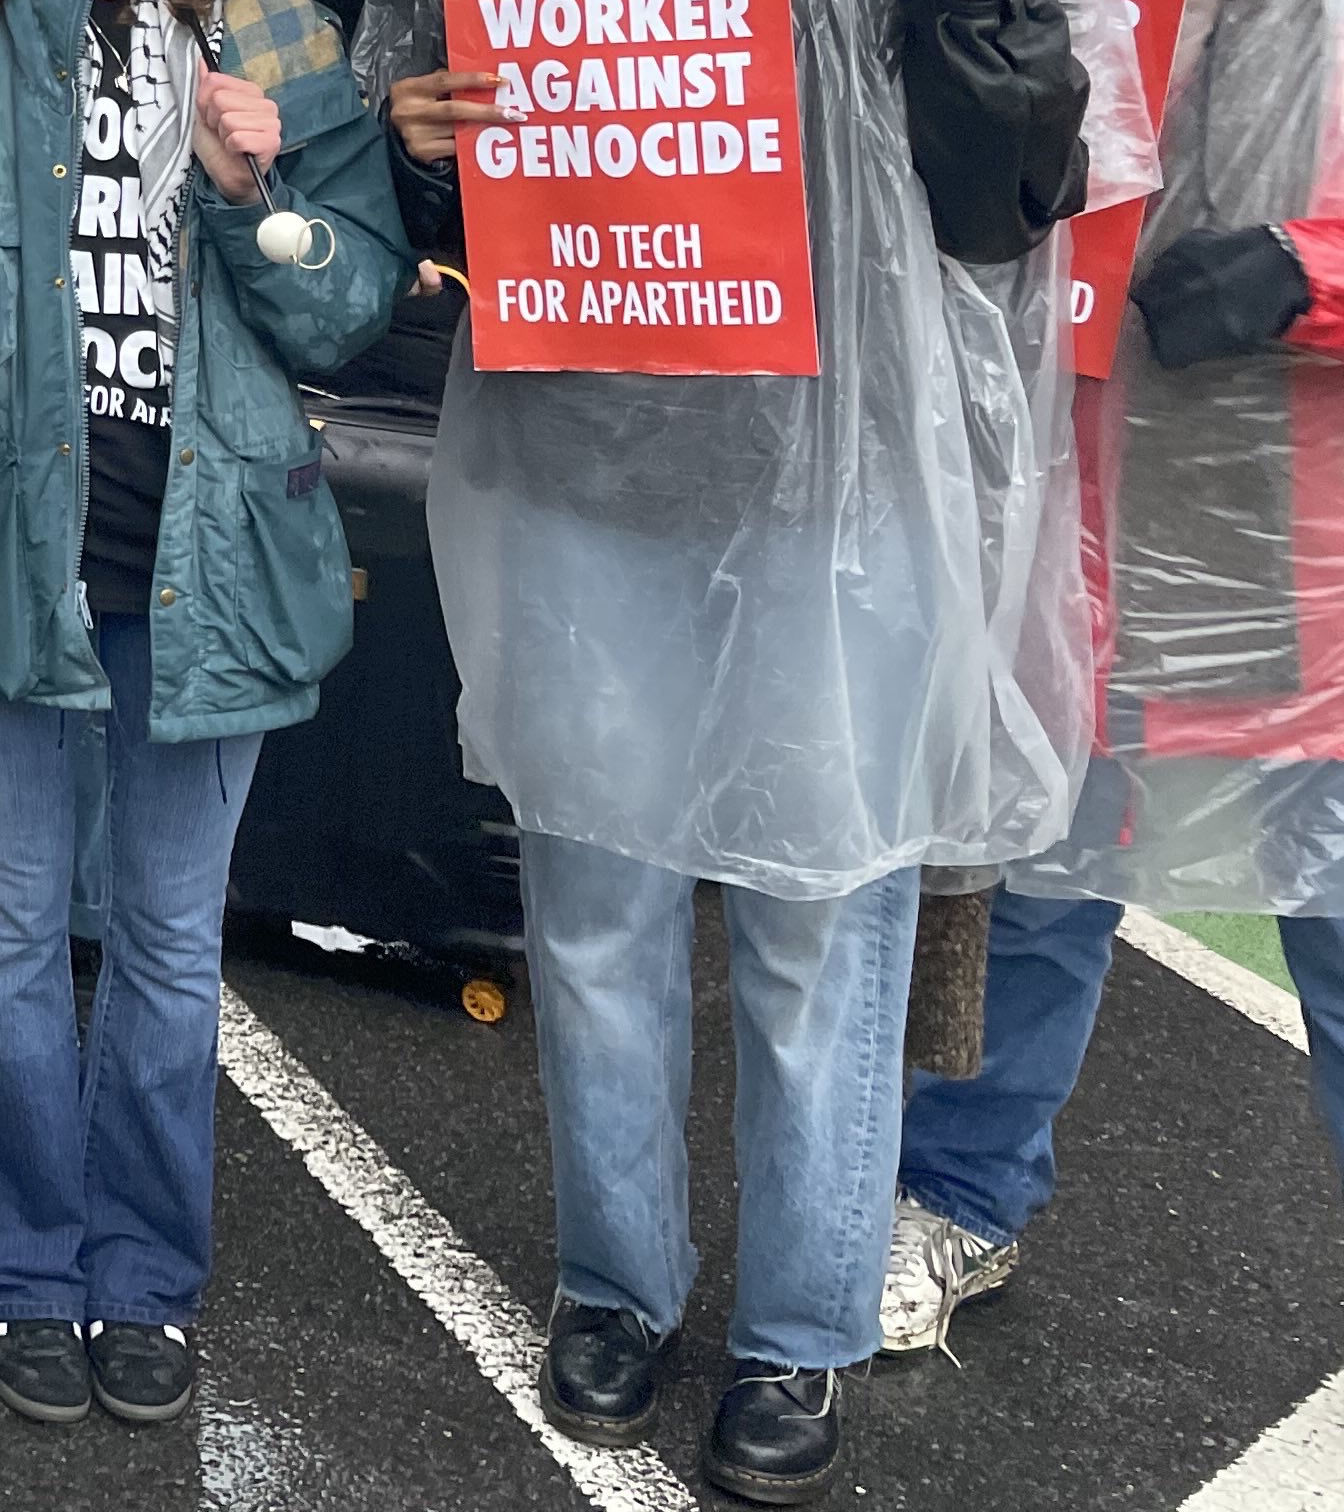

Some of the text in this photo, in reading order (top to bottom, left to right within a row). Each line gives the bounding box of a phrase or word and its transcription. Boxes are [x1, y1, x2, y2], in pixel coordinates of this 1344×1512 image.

[494, 51, 751, 113] AGAINST
[475, 118, 782, 179] GENOCIDE
[550, 223, 702, 269] NO TECH
[497, 279, 782, 326] FOR APARTHEID
